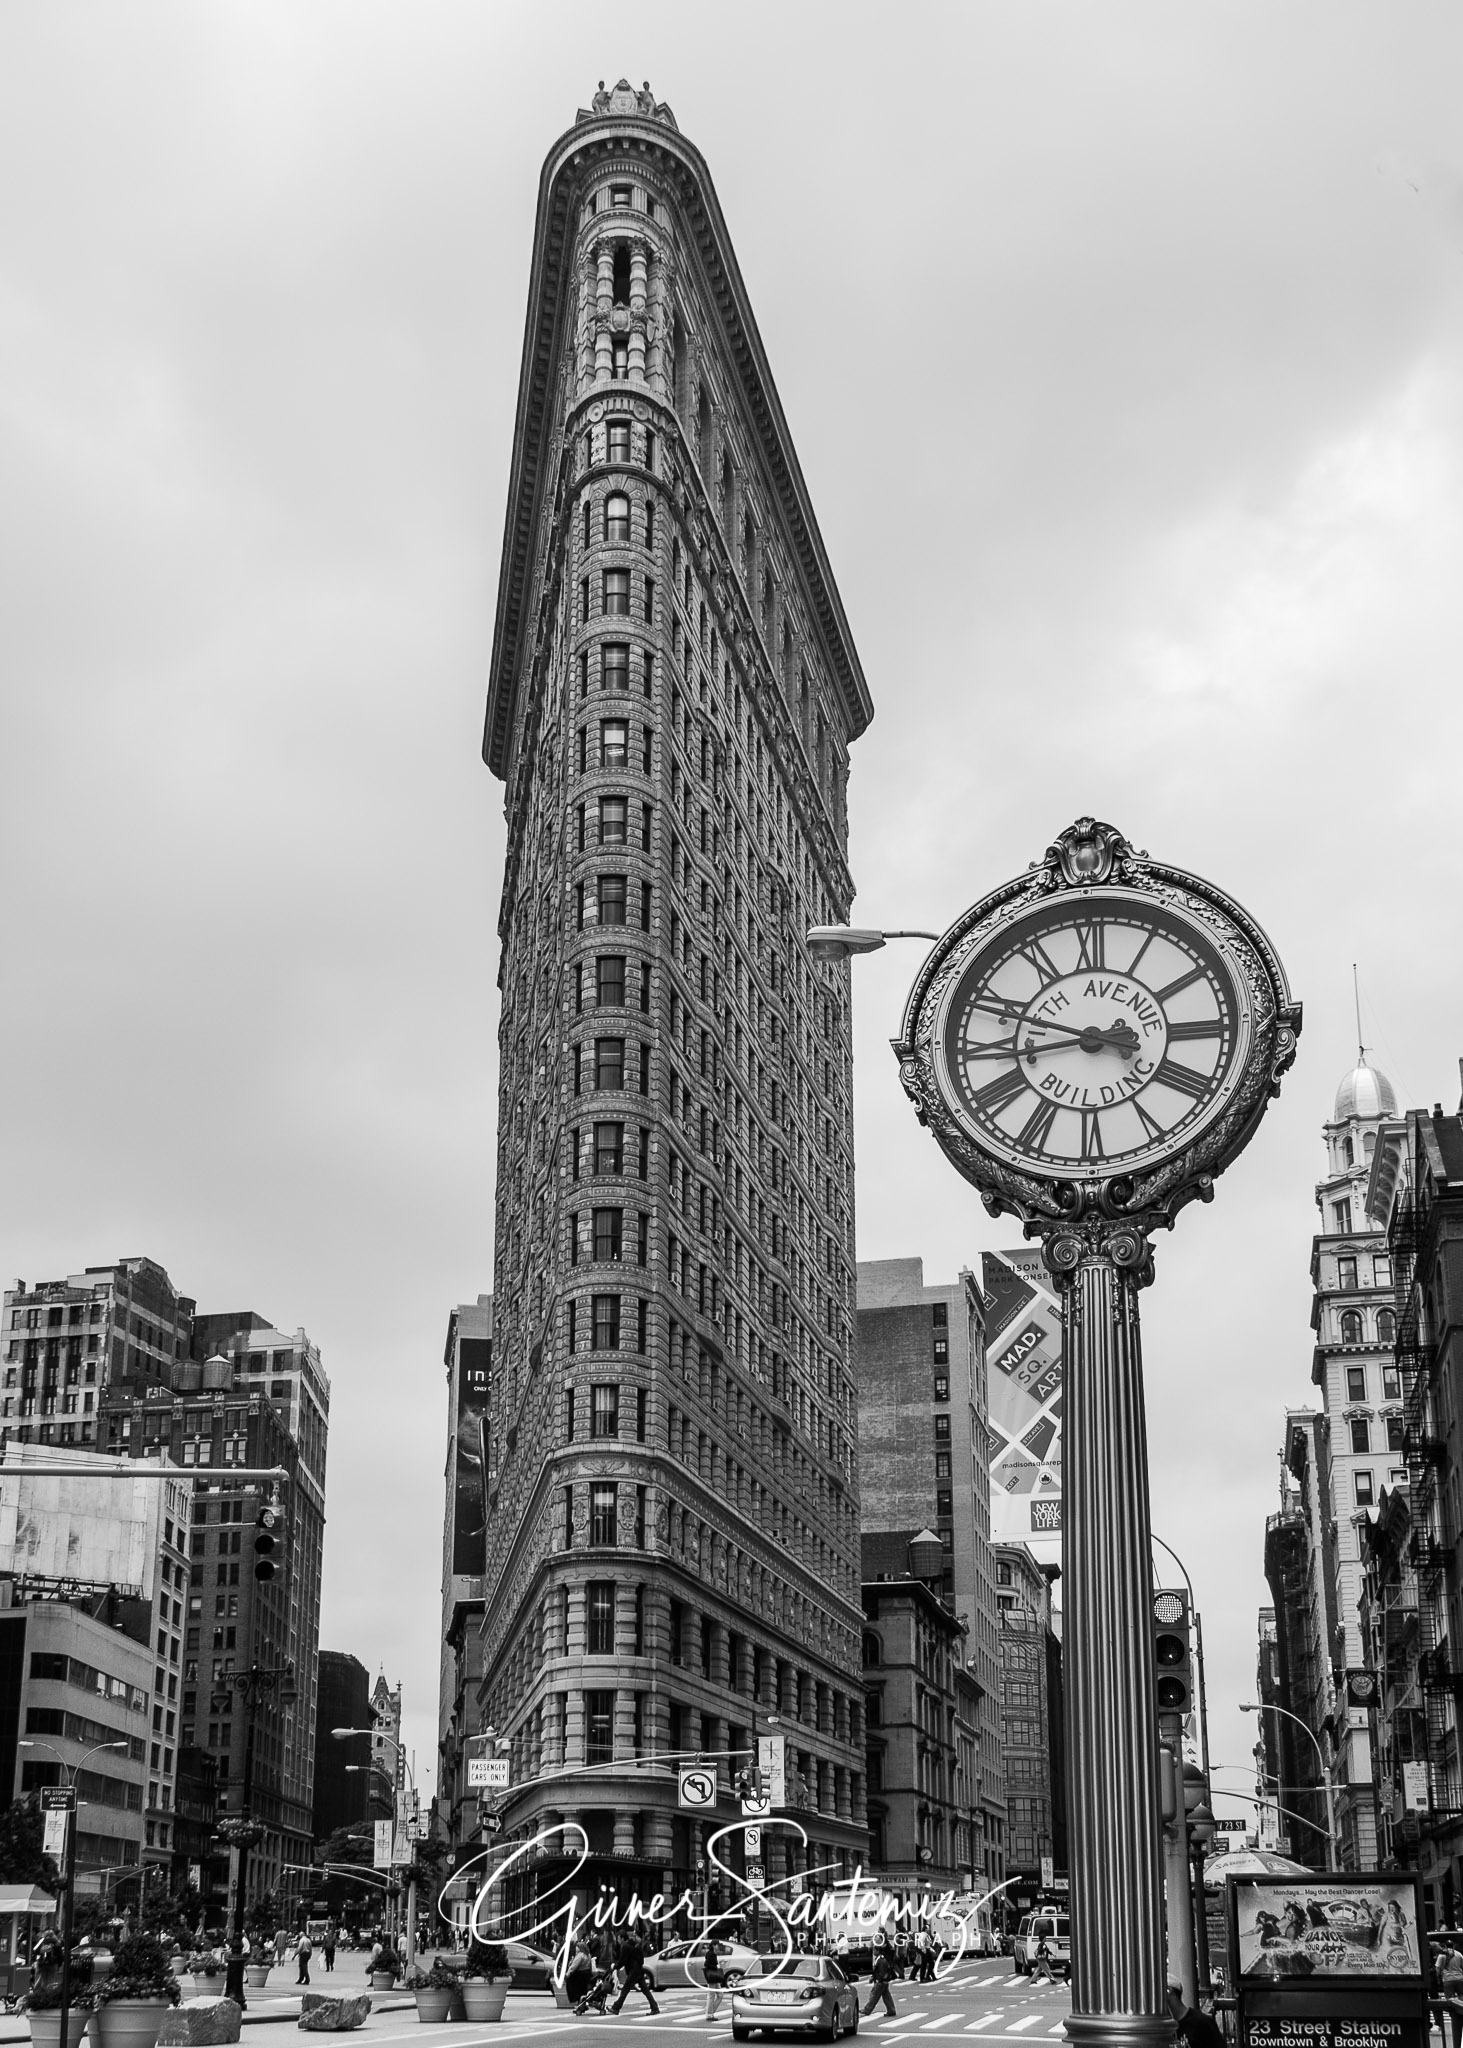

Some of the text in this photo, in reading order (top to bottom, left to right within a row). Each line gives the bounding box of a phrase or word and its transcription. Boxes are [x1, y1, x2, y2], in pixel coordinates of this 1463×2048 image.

[1083, 979, 1163, 1038] AVENUE
[1039, 1057, 1155, 1107] BUILDING
[988, 1263, 1039, 1274] MADISON
[988, 1275, 1013, 1285] PARK
[998, 1310, 1018, 1331] MADISON
[1000, 1332, 1042, 1371] MAD.
[1018, 1360, 1047, 1385] SQ.
[1035, 1502, 1059, 1512] NEW
[1032, 1510, 1062, 1520] YORK
[1036, 1519, 1059, 1528] LIFE
[471, 1763, 506, 1771] PASSENGER
[1225, 1821, 1234, 1831] 23
[1236, 1821, 1243, 1830] ST
[1305, 1888, 1317, 1897] May
[854, 1910, 878, 1919] WDOWS
[1305, 1930, 1346, 1943] DANCE
[1249, 2019, 1401, 2035] 23 Street Station
[1250, 2035, 1388, 2048] Downtown & Brooklyn
